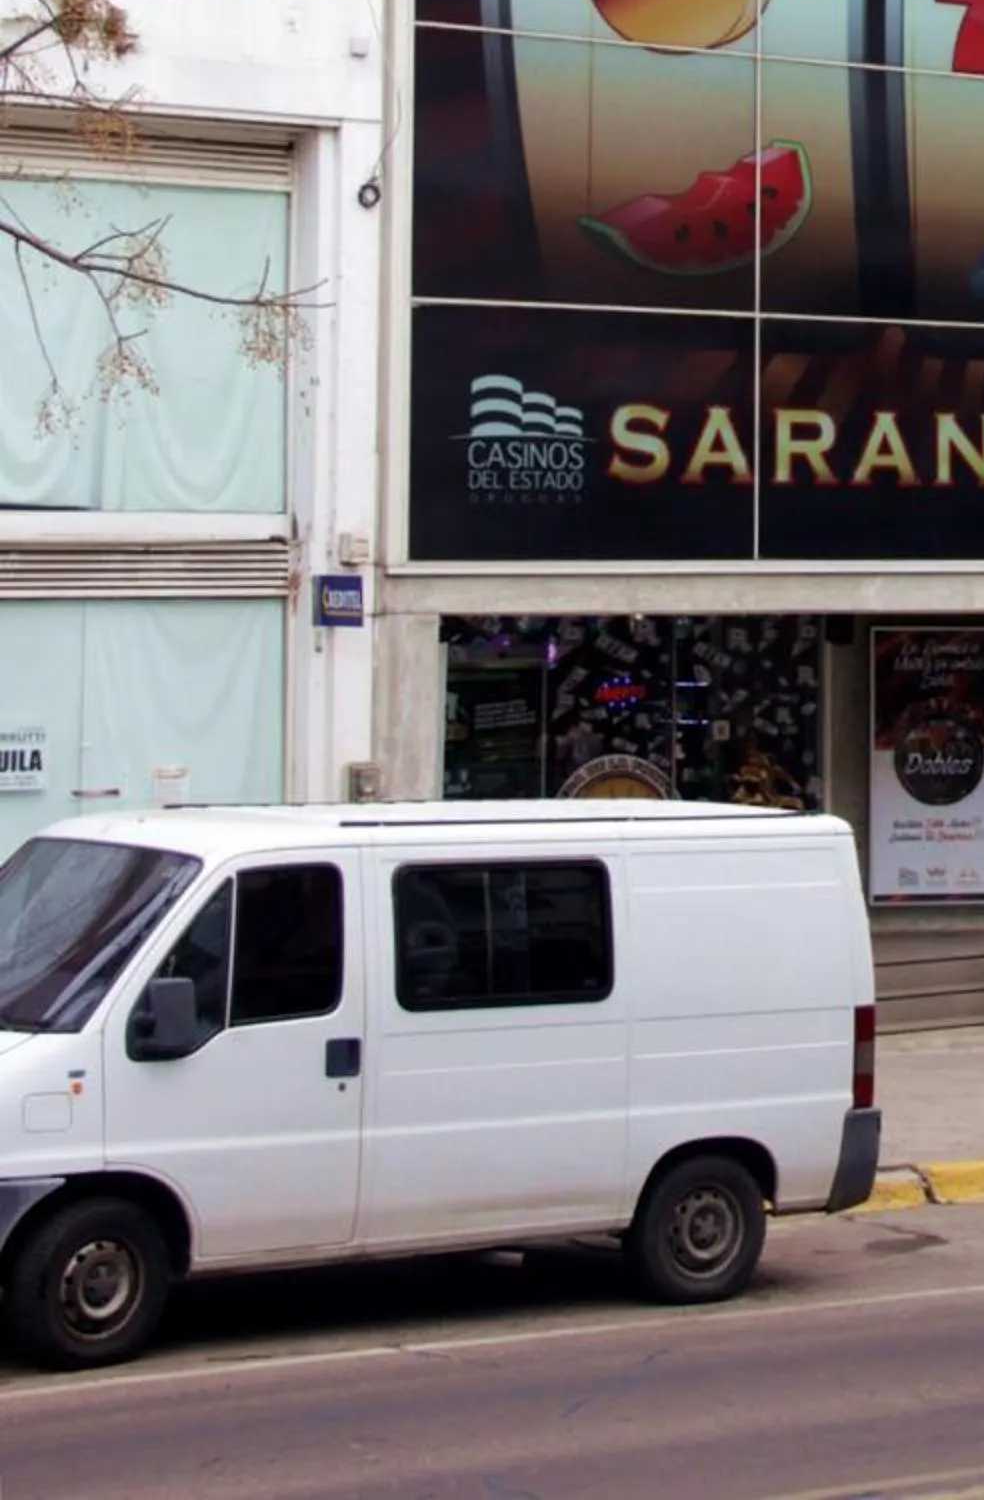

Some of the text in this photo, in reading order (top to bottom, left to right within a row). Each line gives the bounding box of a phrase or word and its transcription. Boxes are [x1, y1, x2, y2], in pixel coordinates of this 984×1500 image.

[467, 440, 585, 470] CASINOS
[468, 470, 585, 492] DEL ESTADO
